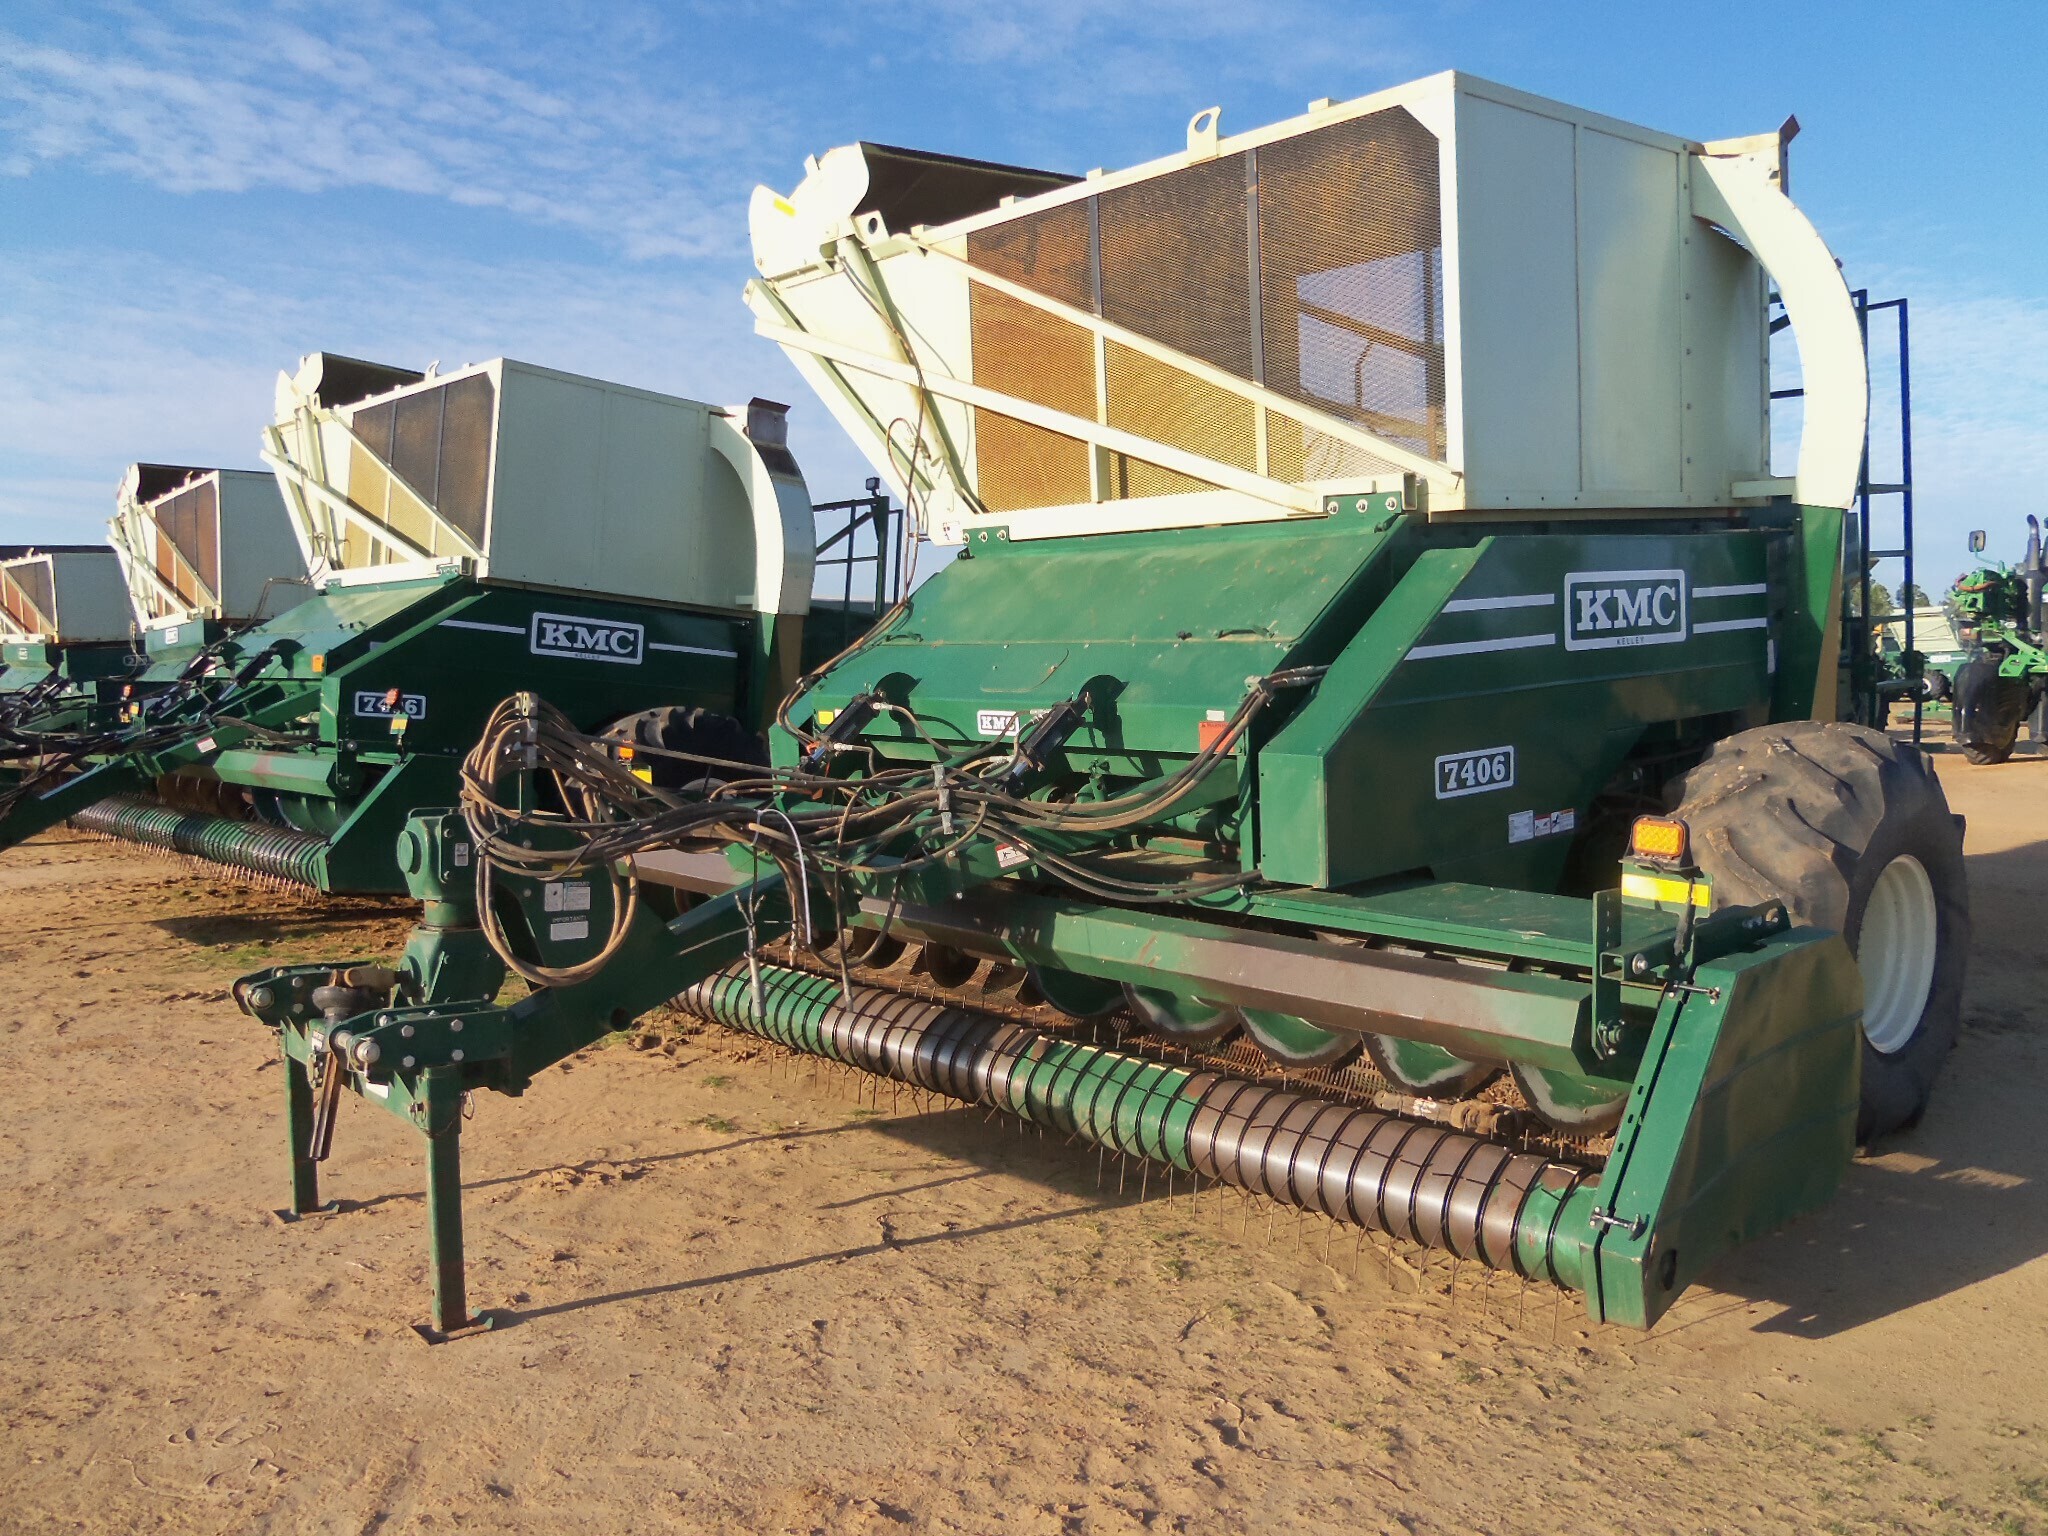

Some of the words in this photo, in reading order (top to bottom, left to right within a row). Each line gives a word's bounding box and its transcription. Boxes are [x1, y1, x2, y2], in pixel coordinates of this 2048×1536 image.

[1576, 585, 1676, 631] KMC
[541, 622, 635, 654] KMC
[363, 696, 418, 715] 746
[1444, 754, 1506, 790] 7406
